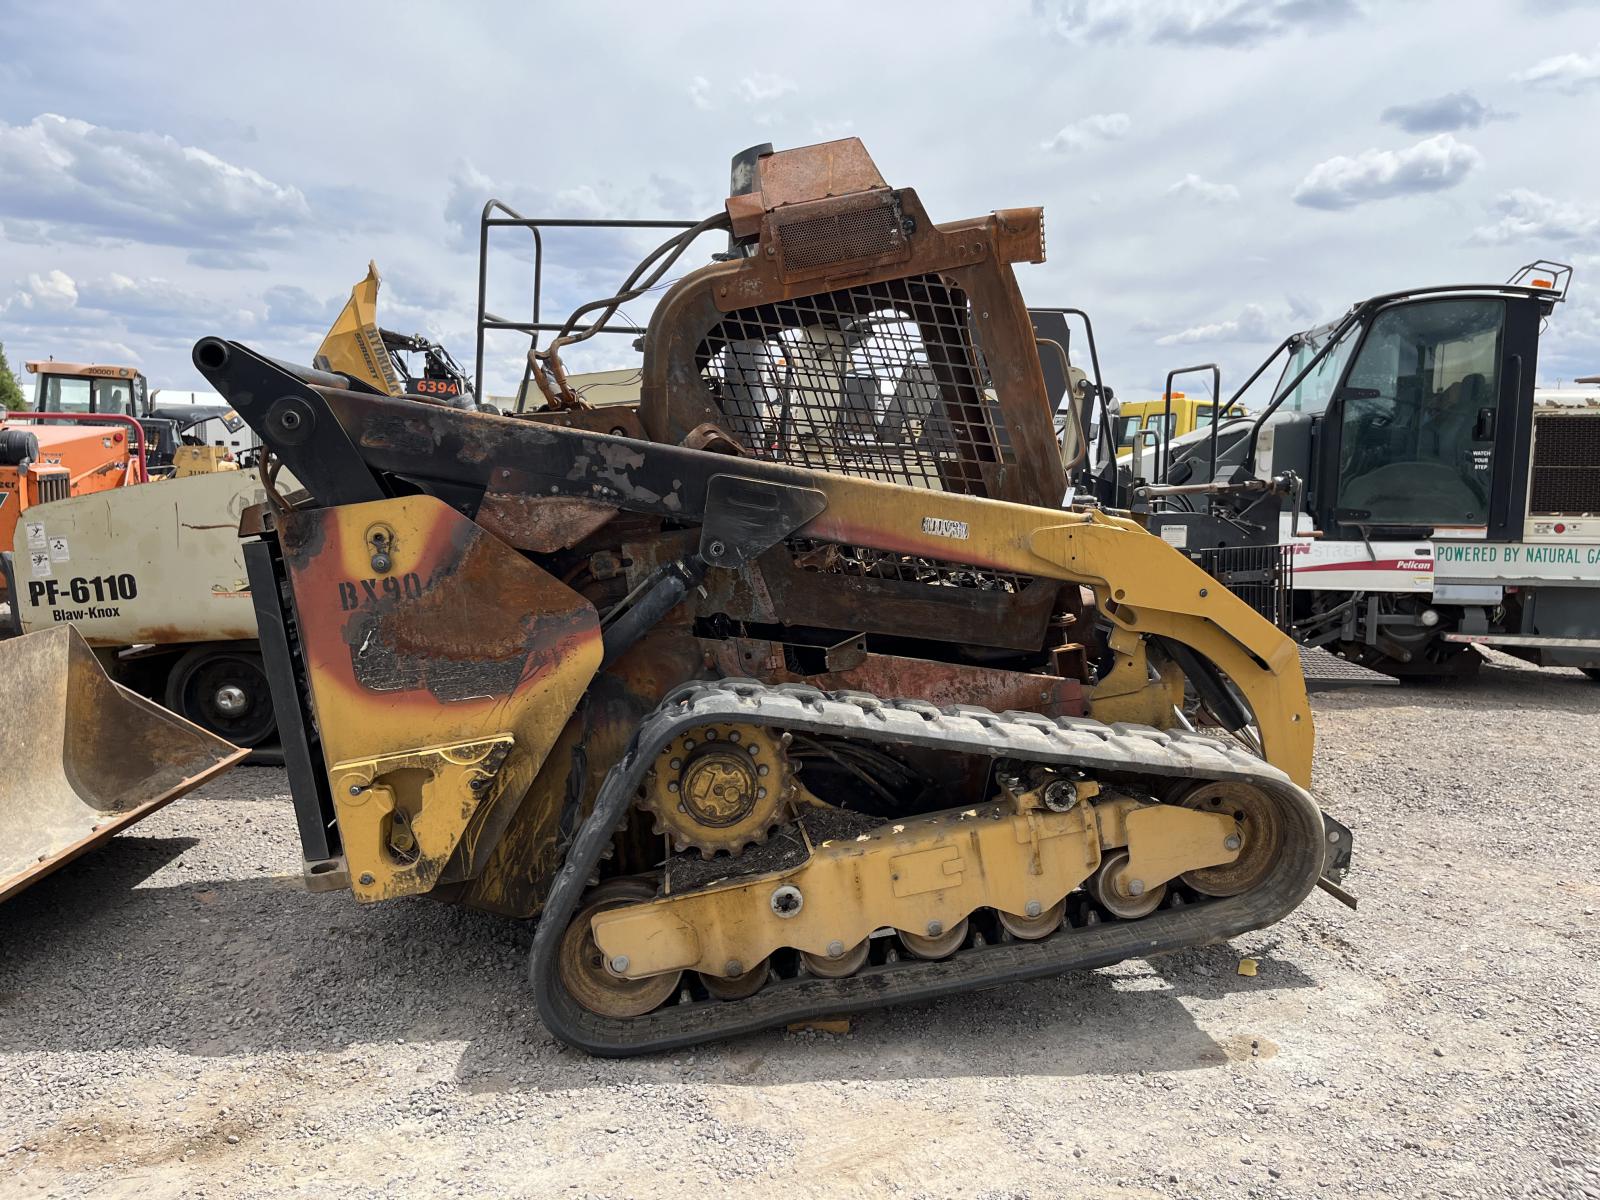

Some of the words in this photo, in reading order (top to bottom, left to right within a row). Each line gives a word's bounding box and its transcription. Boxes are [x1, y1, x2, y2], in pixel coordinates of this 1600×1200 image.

[365, 325, 400, 393] HYDREMA
[416, 380, 458, 395] 6394
[1437, 546, 1497, 562] POWERED
[1503, 547, 1521, 562] BY
[1526, 547, 1581, 564] NATURAL
[1396, 560, 1431, 570] Pelican
[28, 573, 138, 607] PF-6110
[338, 572, 422, 611] BX90
[52, 606, 121, 622] Blaw-Knox
